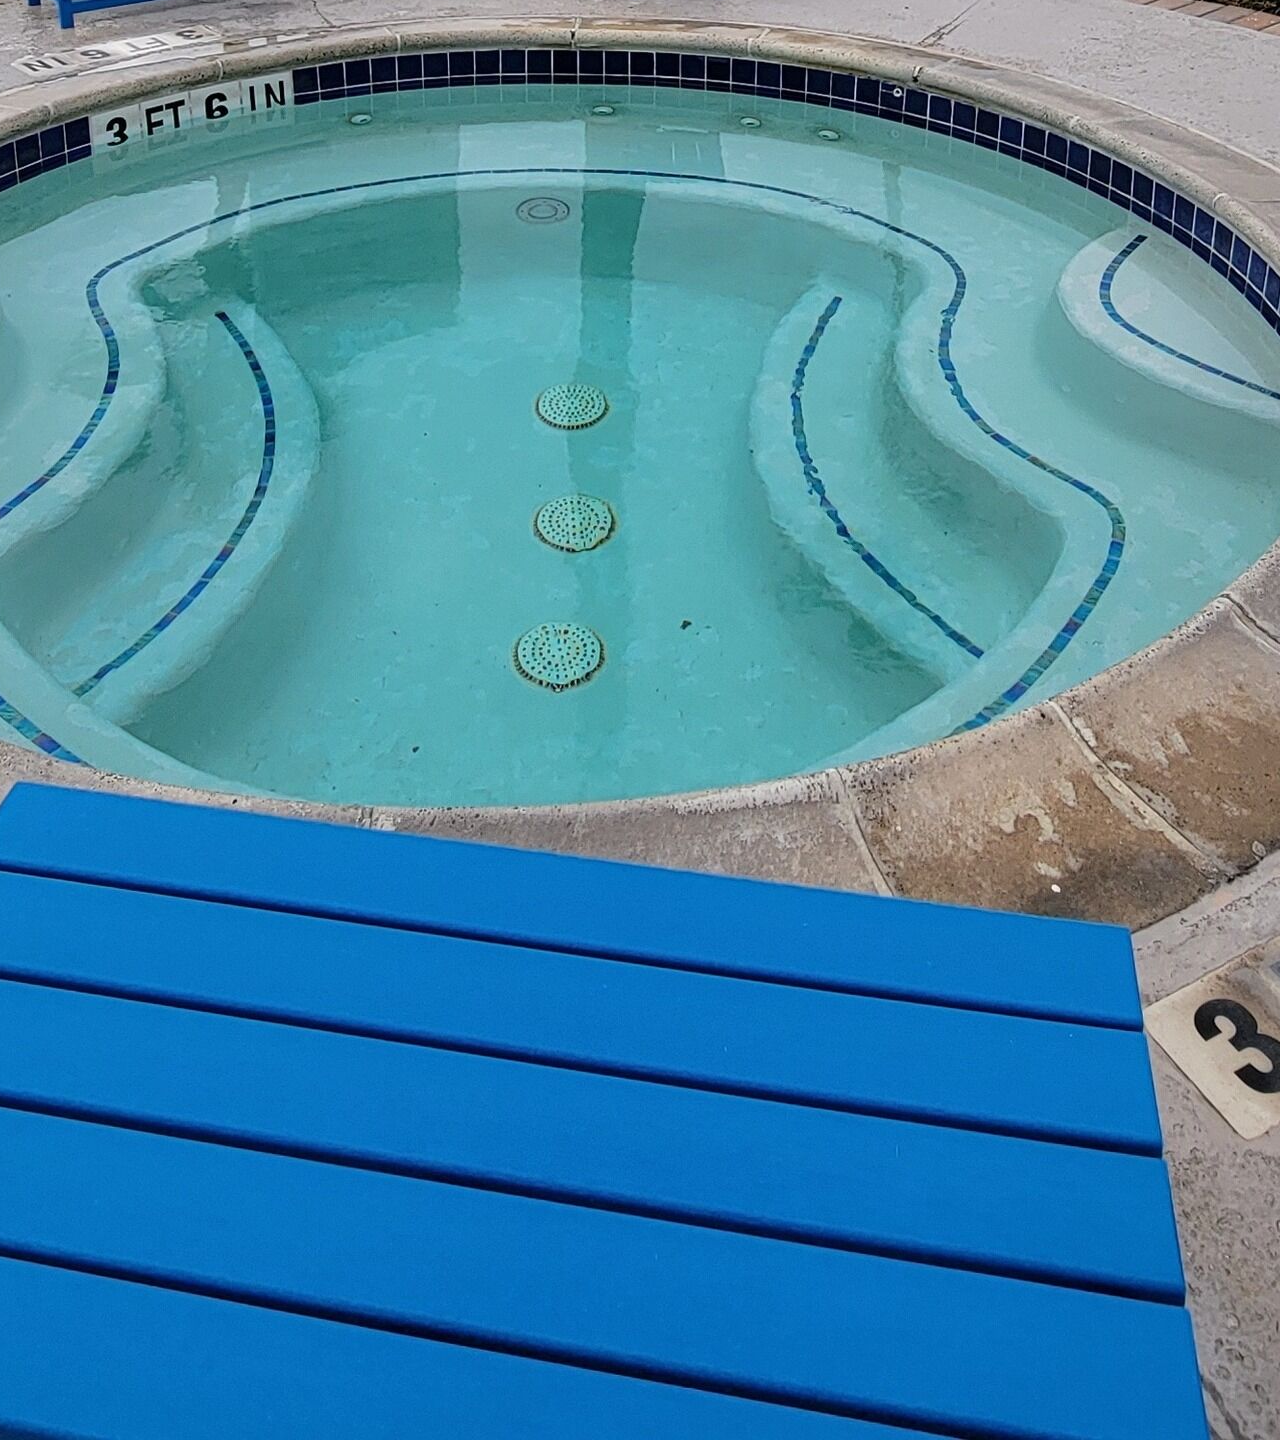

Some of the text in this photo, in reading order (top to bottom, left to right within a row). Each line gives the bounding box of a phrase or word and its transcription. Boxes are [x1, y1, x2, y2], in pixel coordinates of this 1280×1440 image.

[23, 29, 204, 73] 3 FT 6 IN
[106, 80, 286, 147] 3 FT 6 IN
